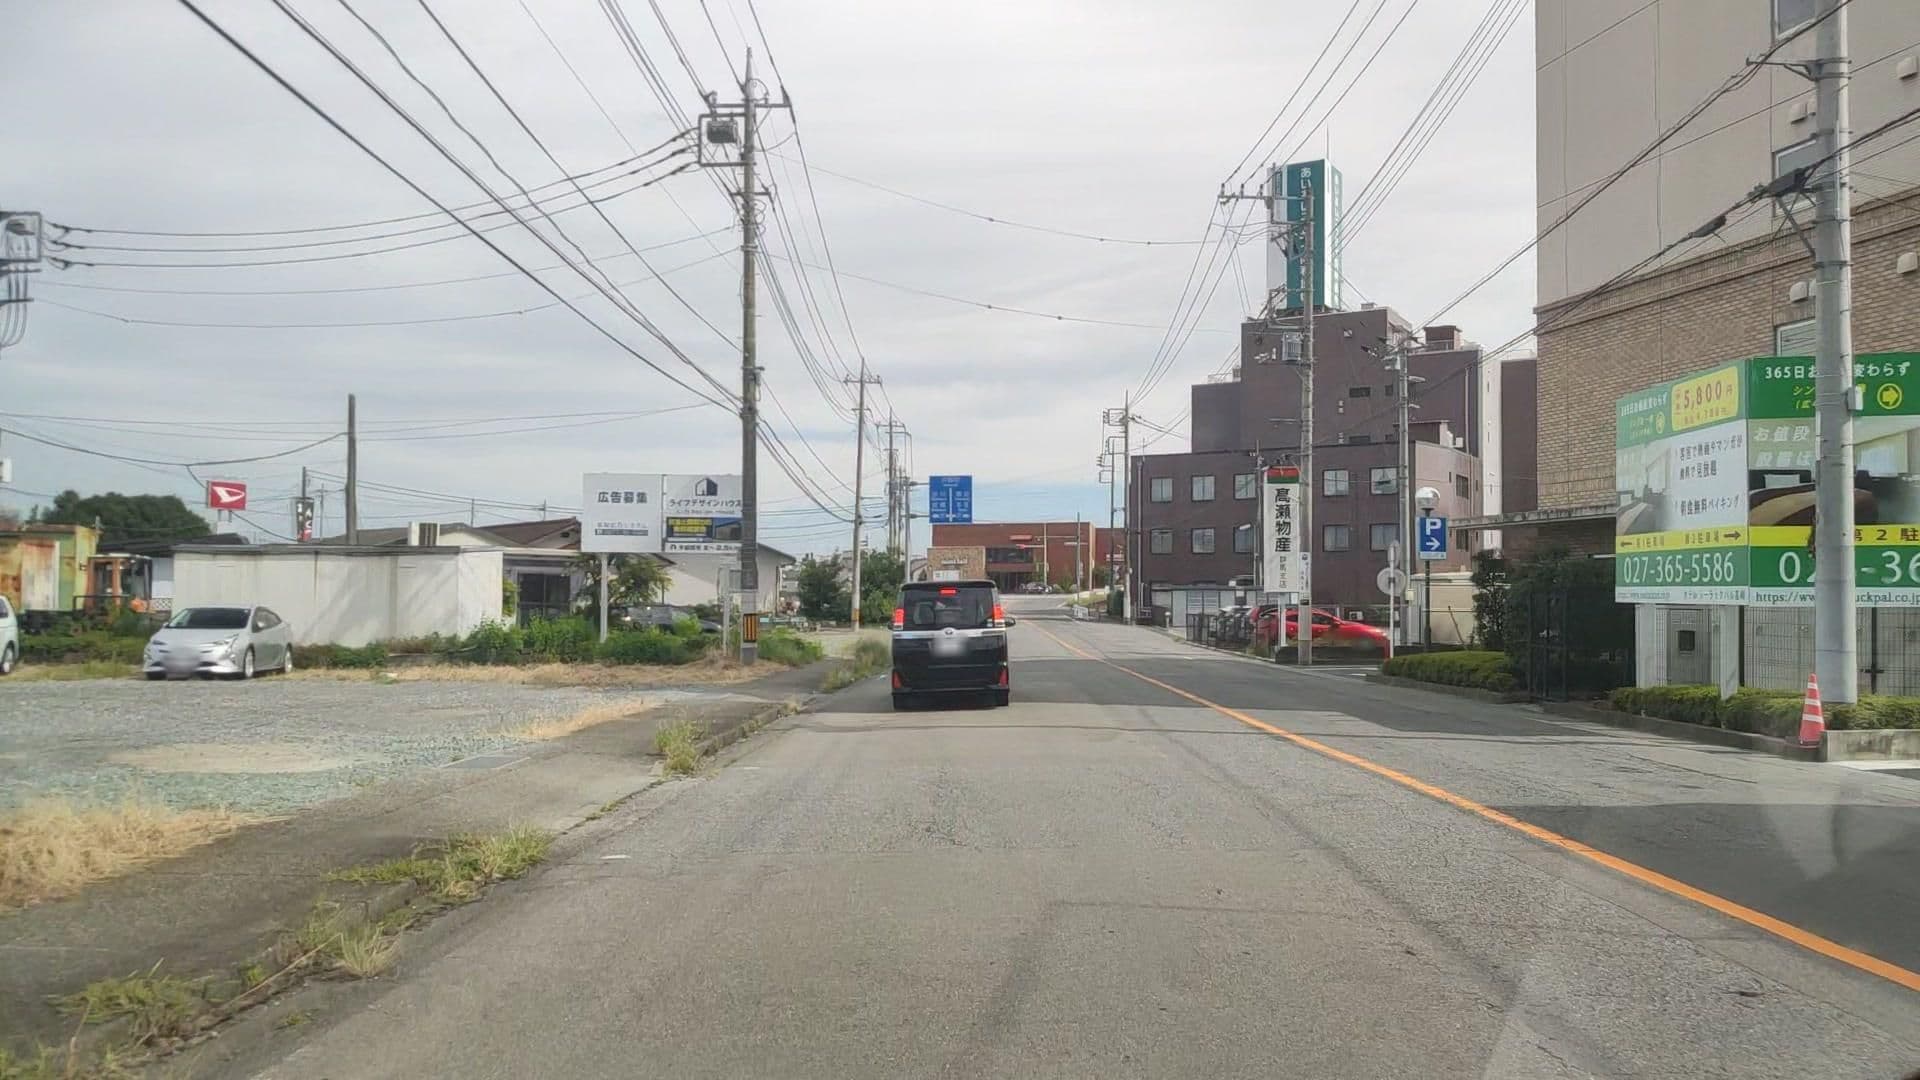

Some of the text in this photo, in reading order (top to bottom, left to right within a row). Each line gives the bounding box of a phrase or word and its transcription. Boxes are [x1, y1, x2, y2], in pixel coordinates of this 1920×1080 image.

[1764, 362, 1911, 379] 365日お変わらず
[1425, 518, 1442, 535] P
[1623, 552, 1734, 583] 027-365-5586
[1779, 550, 1920, 584] 0-36
